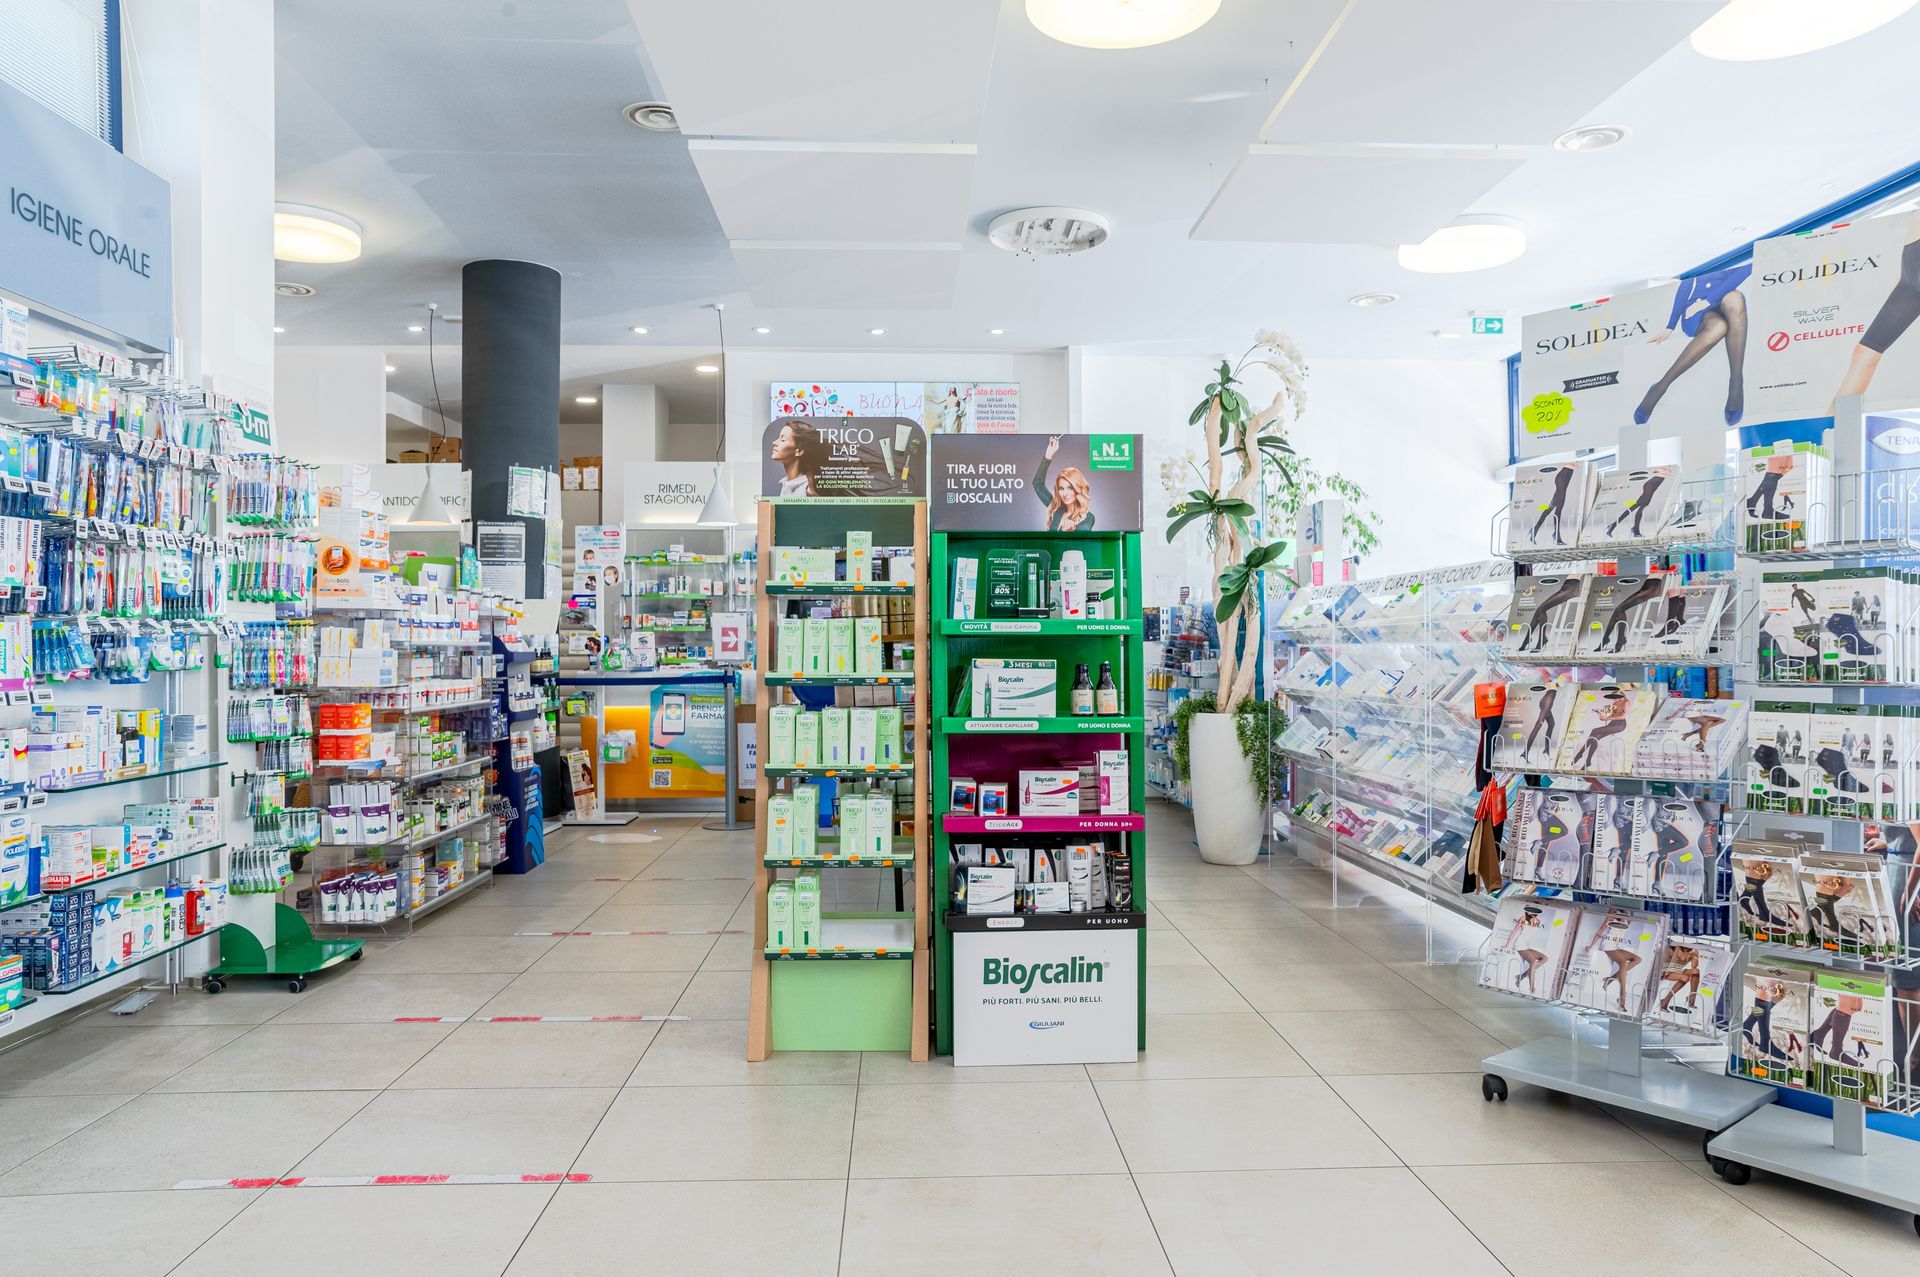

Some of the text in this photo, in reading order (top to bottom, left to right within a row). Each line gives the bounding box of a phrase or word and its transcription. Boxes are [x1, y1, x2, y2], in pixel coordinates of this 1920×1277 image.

[11, 187, 150, 279] IGIENE ORALE
[1762, 256, 1879, 287] SOLIDEA
[1793, 305, 1840, 318] SILVER
[1798, 314, 1834, 325] WAVE
[1536, 321, 1648, 355] SOLIDEA
[1794, 324, 1864, 342] CELLULITE
[1534, 398, 1564, 409] SCONTO
[816, 428, 874, 444] TRICO
[1887, 436, 1920, 446] TENA
[946, 464, 1016, 474] TIRA FUORI
[658, 484, 696, 494] RIMEDI
[947, 478, 1024, 489] IL TUO LATO
[644, 494, 707, 504] STAGIONAL
[946, 493, 1013, 504] BIOSCALIN
[1448, 565, 1482, 584] CORPO
[1524, 793, 1532, 826] WELLNESS
[6, 844, 26, 855] POLIDENT
[982, 996, 996, 1005] PIÙ
[1026, 996, 1039, 1004] PIÙ
